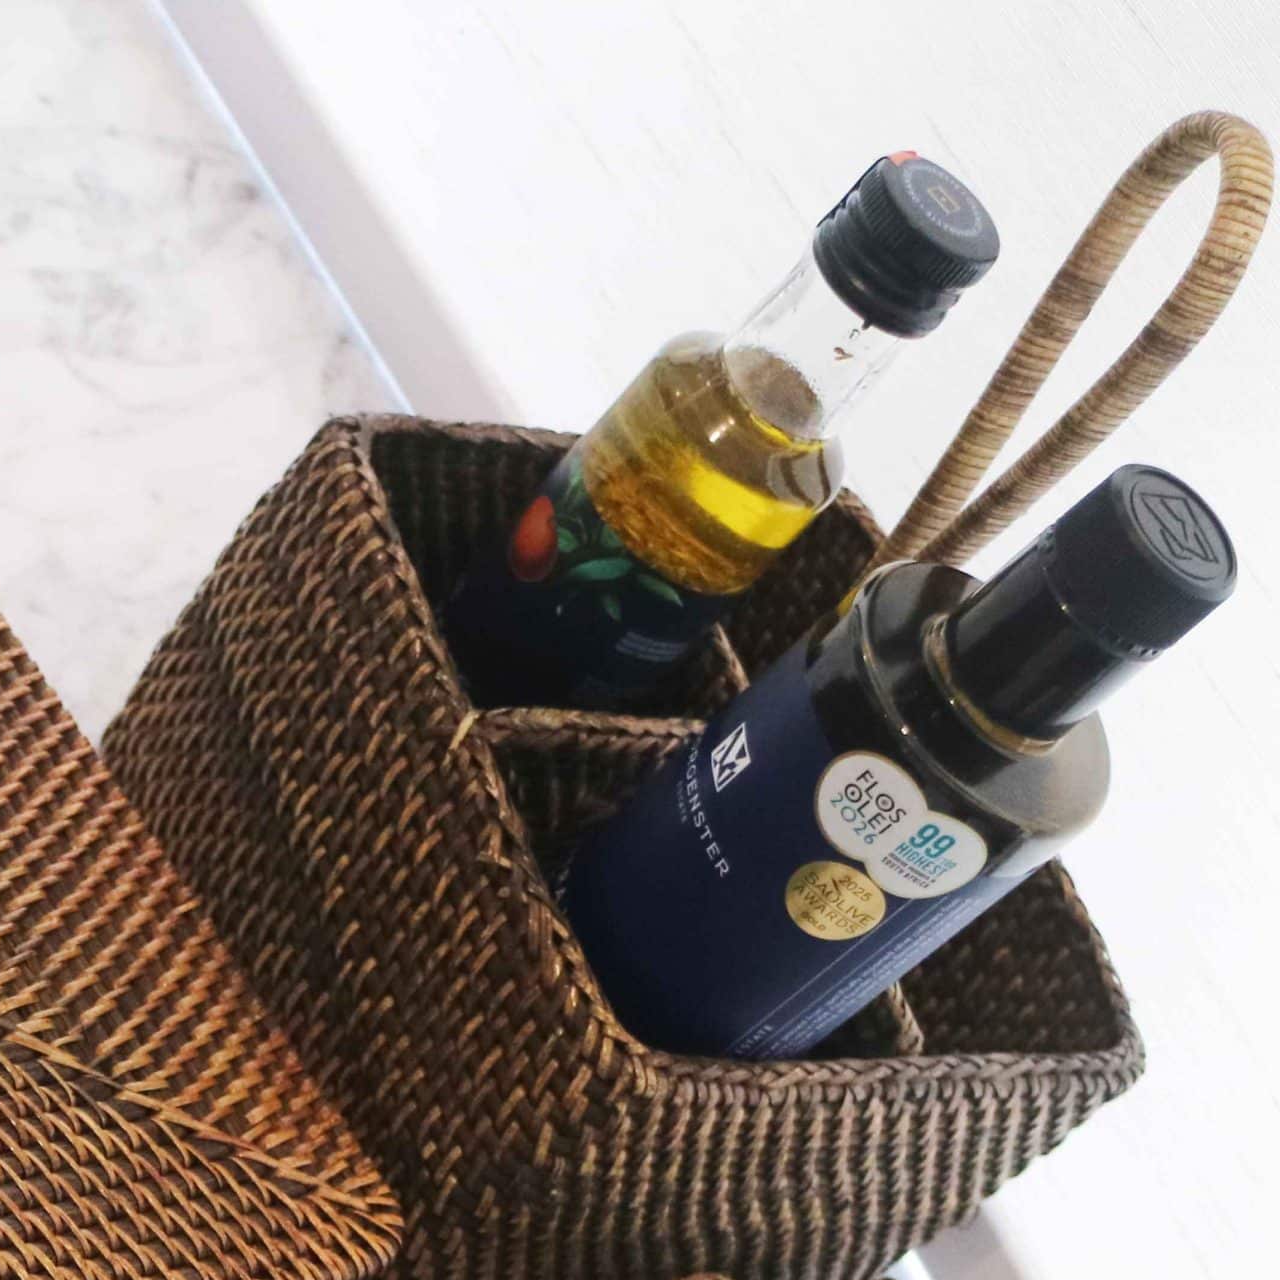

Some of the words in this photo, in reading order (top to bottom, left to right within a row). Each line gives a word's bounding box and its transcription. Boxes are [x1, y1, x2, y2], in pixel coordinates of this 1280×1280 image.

[830, 792, 877, 845] 2026
[844, 783, 892, 834] OLEI
[856, 769, 907, 823] FLOS
[894, 842, 948, 878] HIGHEST
[909, 823, 956, 858] 99
[792, 885, 859, 934] AWARDS
